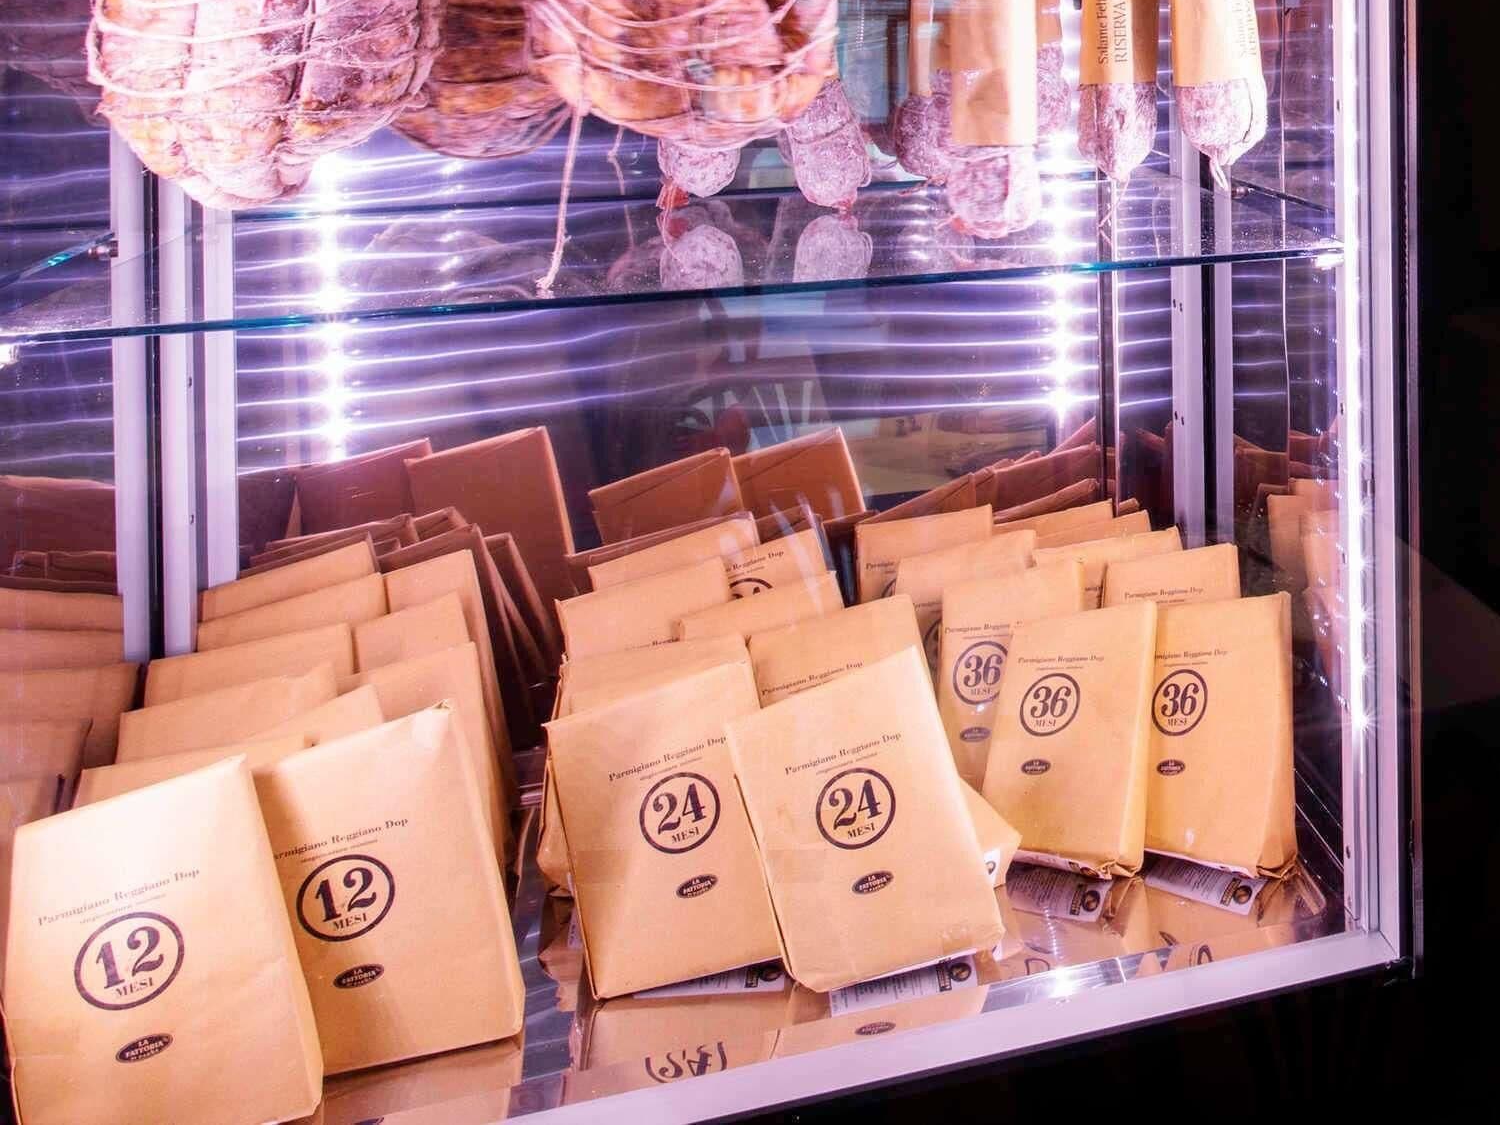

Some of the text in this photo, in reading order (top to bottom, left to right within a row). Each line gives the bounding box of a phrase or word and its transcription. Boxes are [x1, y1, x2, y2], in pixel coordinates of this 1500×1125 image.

[1097, 23, 1110, 65] Salame
[1112, 1, 1128, 63] RISERVA
[963, 653, 1003, 688] 36
[1030, 685, 1072, 718] 36
[1161, 682, 1200, 717] 36
[608, 760, 661, 782] Parmigiano
[663, 743, 705, 763] Reggiano
[707, 736, 727, 748] Dop
[784, 754, 837, 776] Parmigiano
[839, 739, 881, 757] Reggiano
[882, 732, 902, 744] Dop
[652, 782, 707, 835] 24
[828, 778, 883, 831] 24
[331, 826, 382, 844] Reggiano
[385, 818, 409, 830] Dop
[671, 826, 700, 844] MESI
[847, 822, 876, 839] MESI
[37, 896, 111, 927] Parmigiano
[114, 877, 171, 902] Reggiano
[315, 866, 377, 923] 12
[332, 912, 368, 931] MESI
[95, 925, 165, 990] 12
[115, 976, 155, 999] MESI
